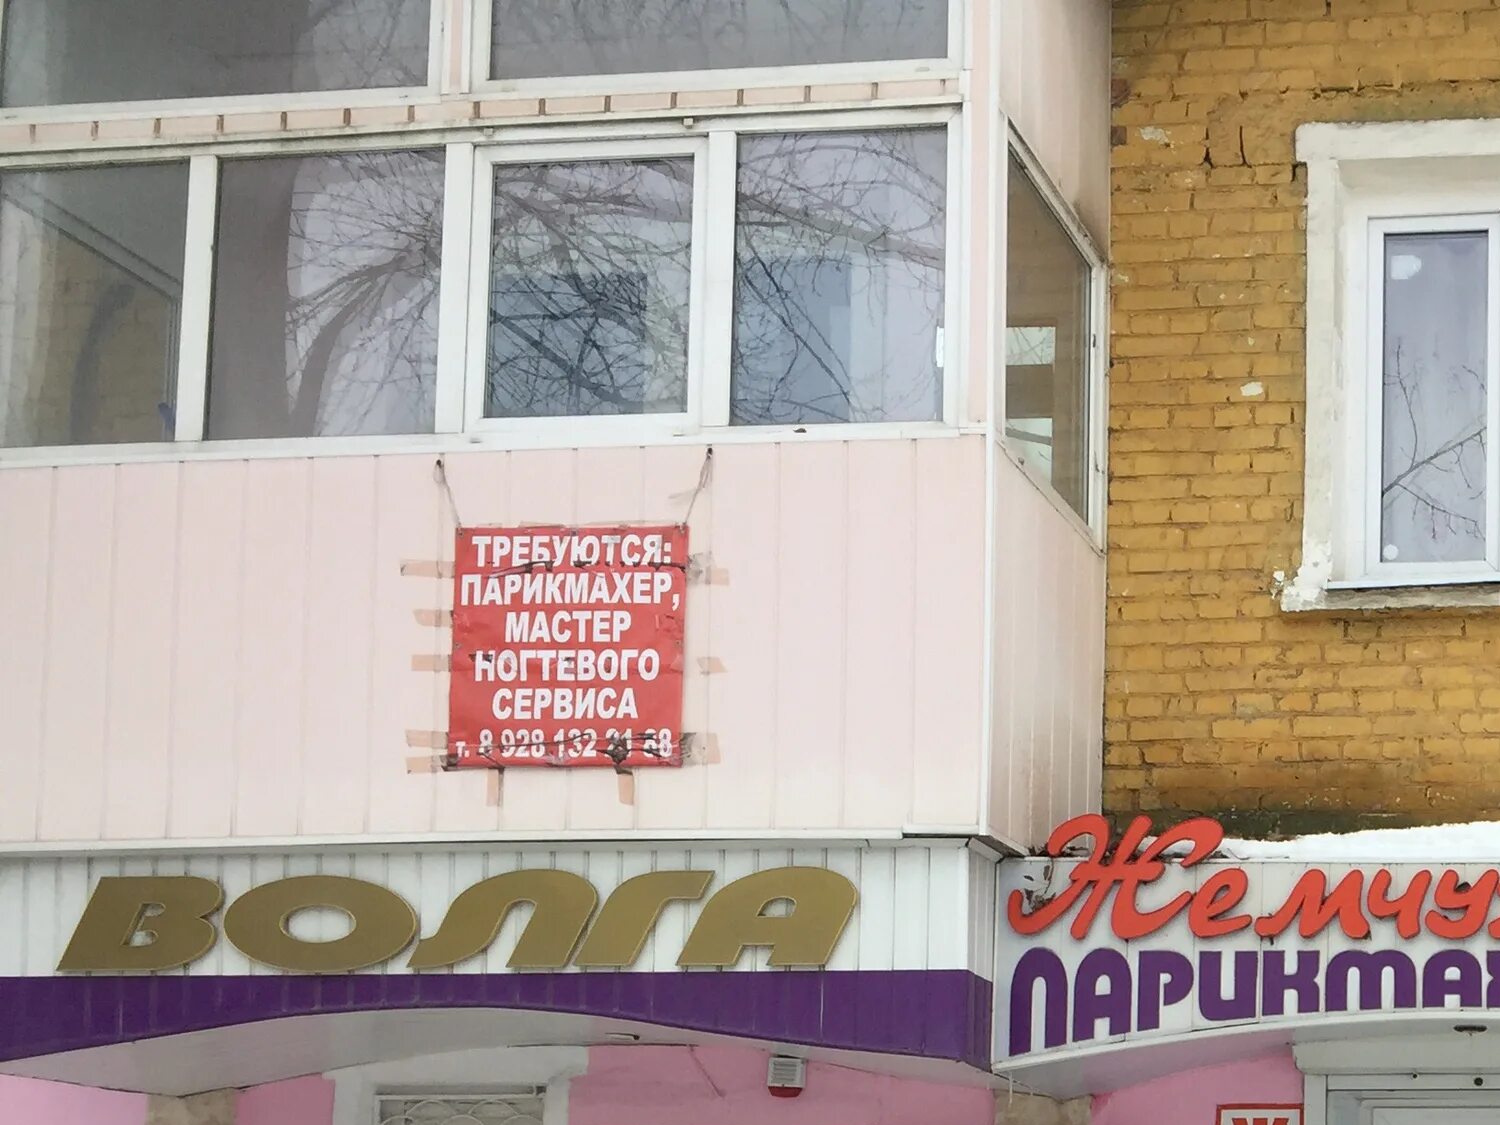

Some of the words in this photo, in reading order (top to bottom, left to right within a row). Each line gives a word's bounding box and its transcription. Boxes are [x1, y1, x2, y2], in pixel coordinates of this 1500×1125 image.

[472, 534, 672, 567] ТРЕБУЮТСЯ:
[461, 573, 680, 611] ПАРИКМАХЕР,
[505, 611, 632, 643] МАСТЕР
[474, 649, 659, 681] НОГТЕВОГО
[492, 688, 638, 719] СЕРВИСА
[501, 729, 545, 757] 928
[554, 728, 597, 757] 132
[56, 866, 858, 973] ВОЛГА
